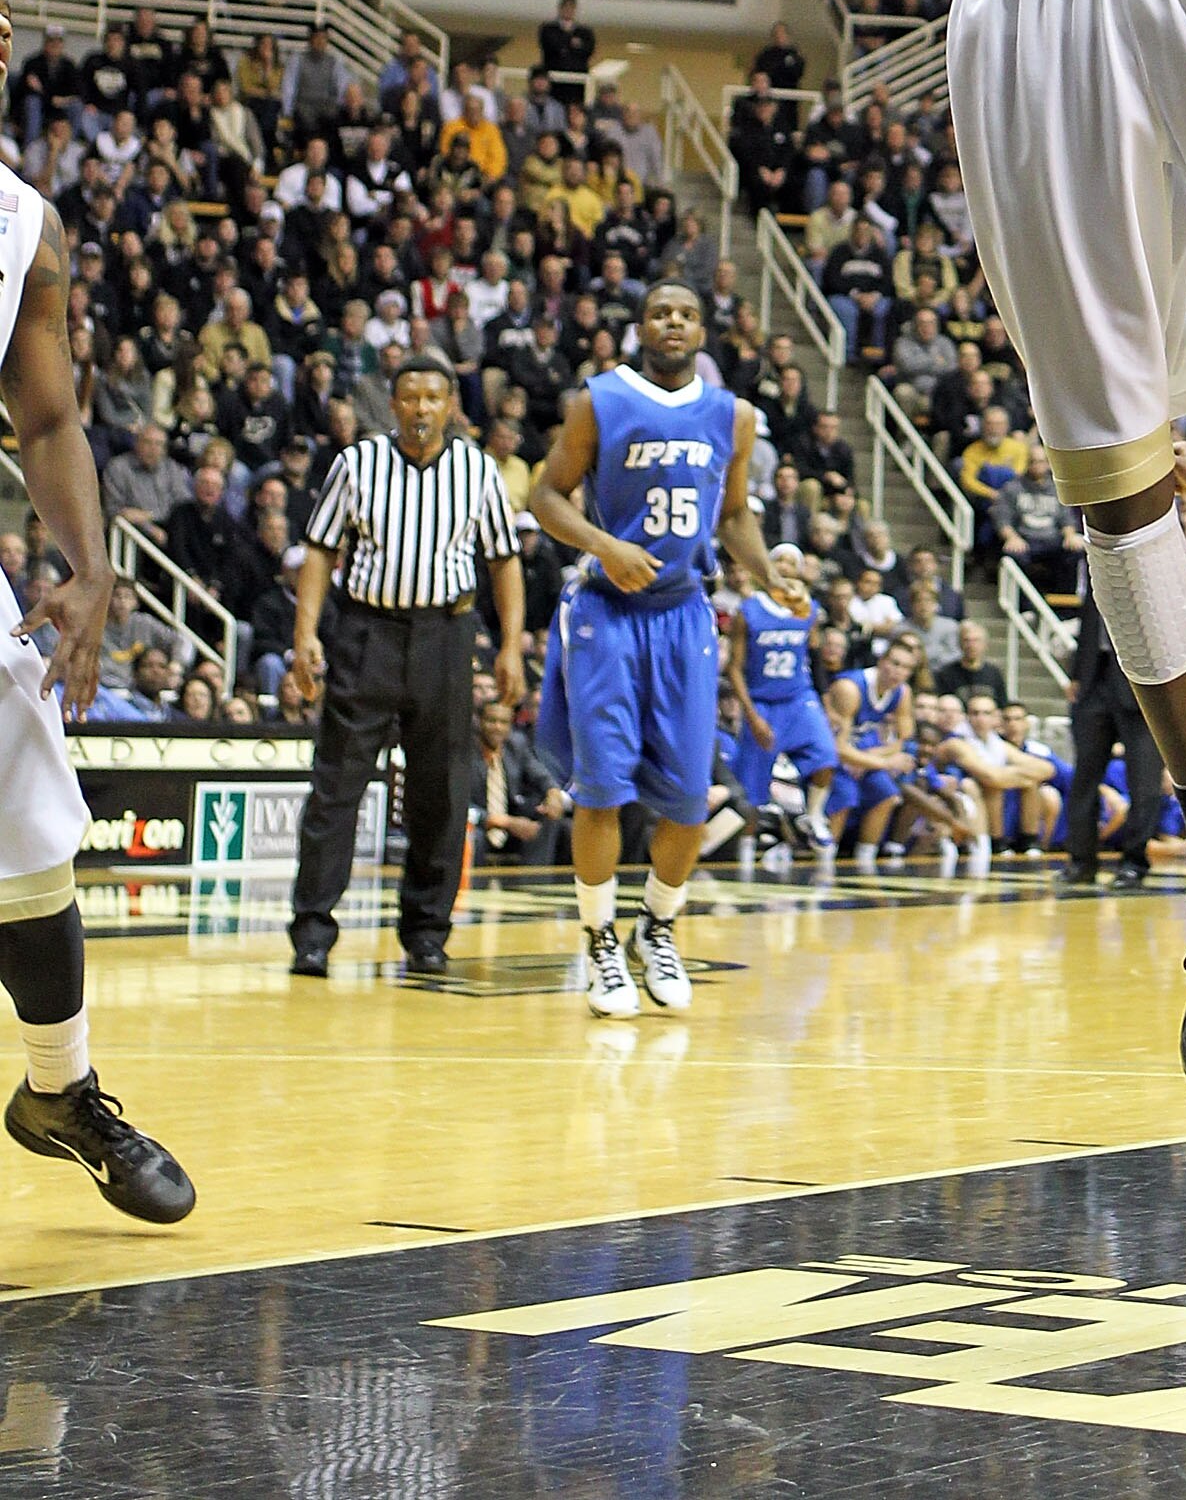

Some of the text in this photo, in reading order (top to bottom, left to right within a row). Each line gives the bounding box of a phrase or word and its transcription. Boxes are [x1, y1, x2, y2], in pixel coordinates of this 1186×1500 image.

[624, 440, 713, 469] IPFW
[643, 486, 699, 538] 35
[762, 650, 797, 678] 22
[254, 798, 303, 834] IVY
